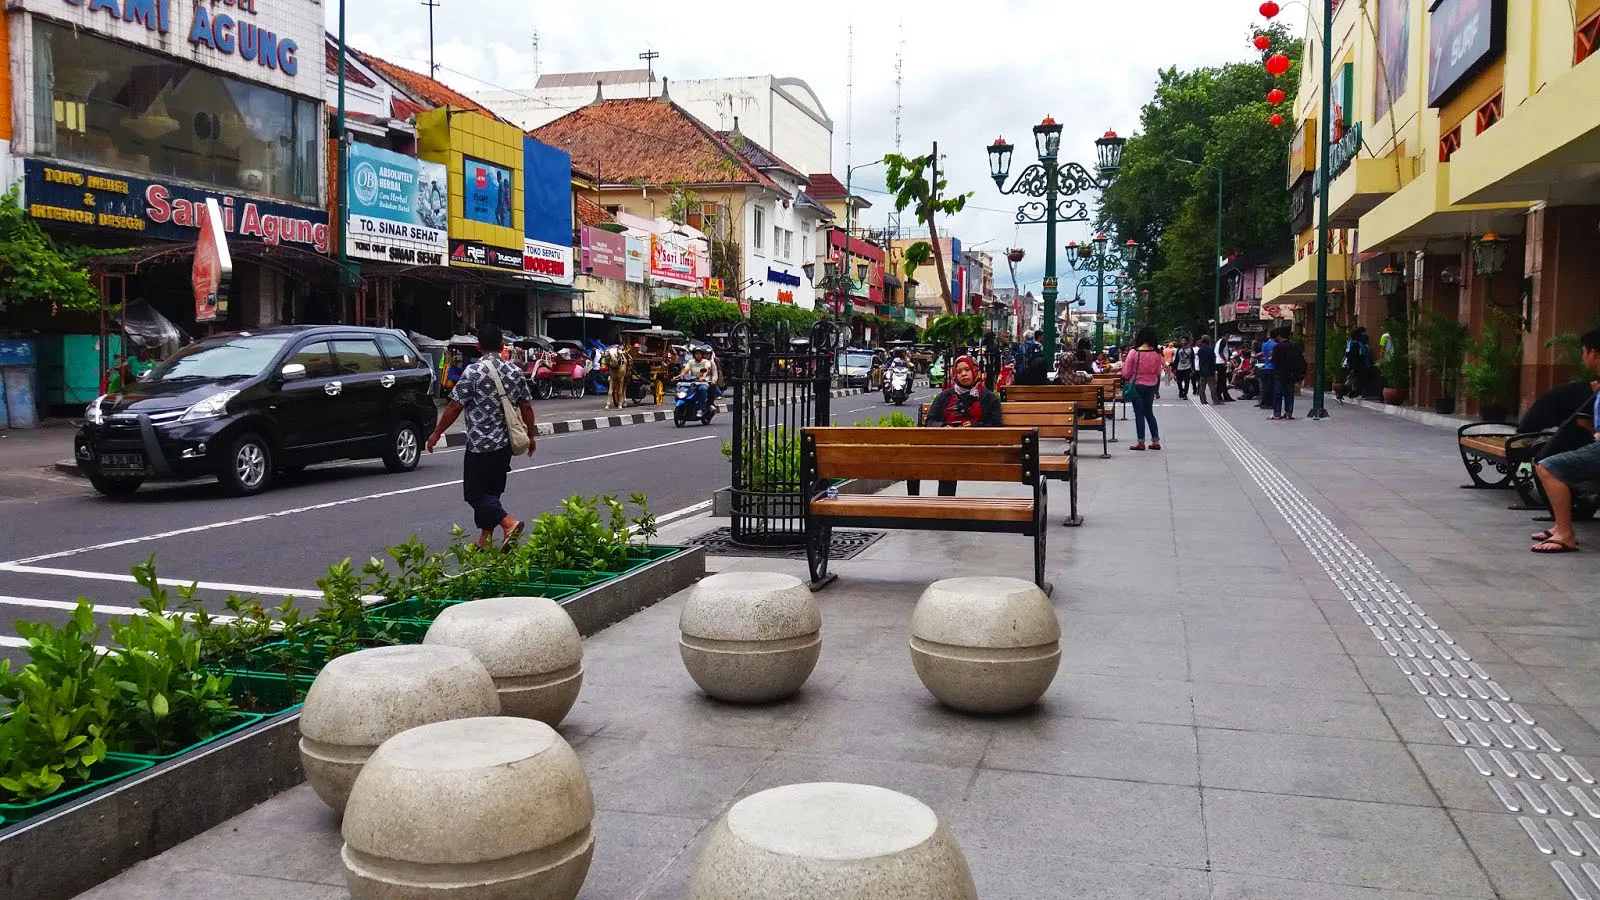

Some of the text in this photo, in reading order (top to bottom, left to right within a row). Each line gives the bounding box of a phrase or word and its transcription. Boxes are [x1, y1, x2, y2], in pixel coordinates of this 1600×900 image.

[63, 0, 298, 76] MI AGUNG
[44, 167, 129, 195] TOKO MEBEL
[379, 166, 413, 183] ABSOLUTELY
[379, 177, 401, 192] HERBAL
[83, 192, 96, 207] &
[29, 203, 96, 225] INTERIOR
[240, 202, 330, 254] Agung
[360, 218, 439, 243] TO. SINAR SEHAT
[354, 241, 370, 251] TOKO
[389, 246, 415, 263] SINAR
[417, 250, 442, 265] SEHAT
[526, 245, 561, 260] TOKO SEPATU
[662, 249, 677, 264] Sari
[523, 255, 565, 276] MODERN
